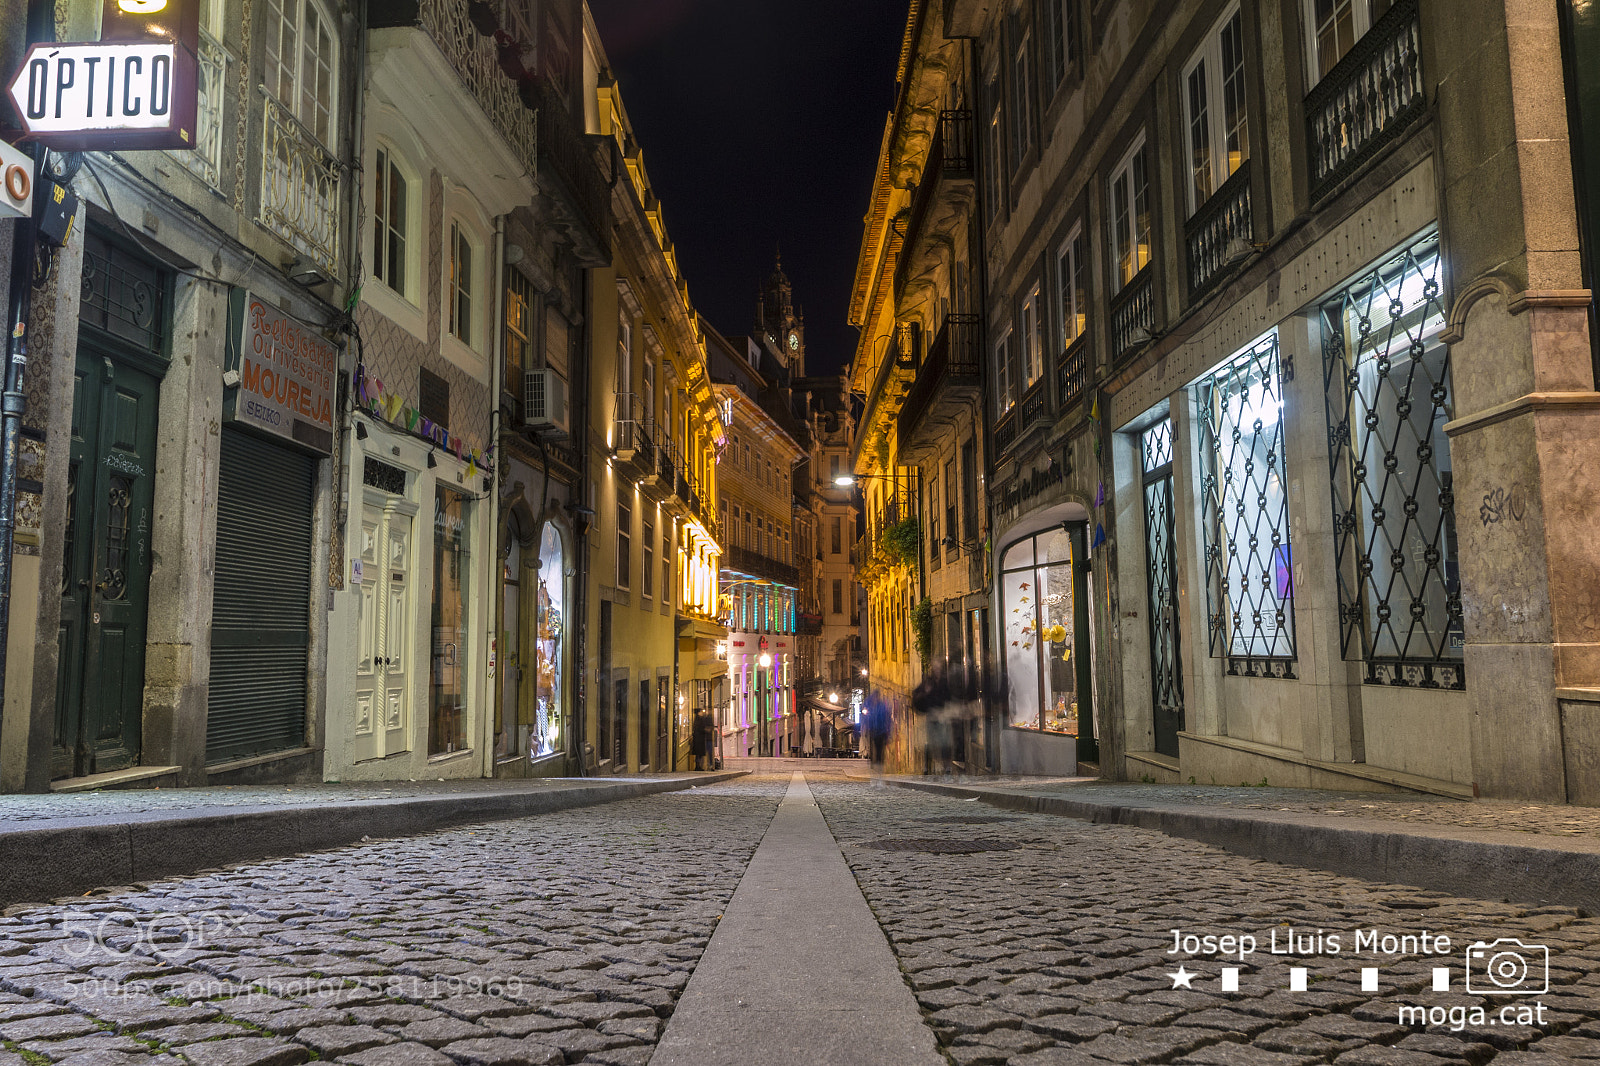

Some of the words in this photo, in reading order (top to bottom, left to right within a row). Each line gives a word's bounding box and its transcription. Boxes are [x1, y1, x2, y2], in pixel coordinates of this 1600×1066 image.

[26, 50, 171, 120] ÓPTICO
[250, 302, 334, 374] Relojoaria
[253, 333, 330, 391] Ourivesaria
[243, 358, 332, 427] MOUREJA
[246, 401, 281, 425] SEIKO
